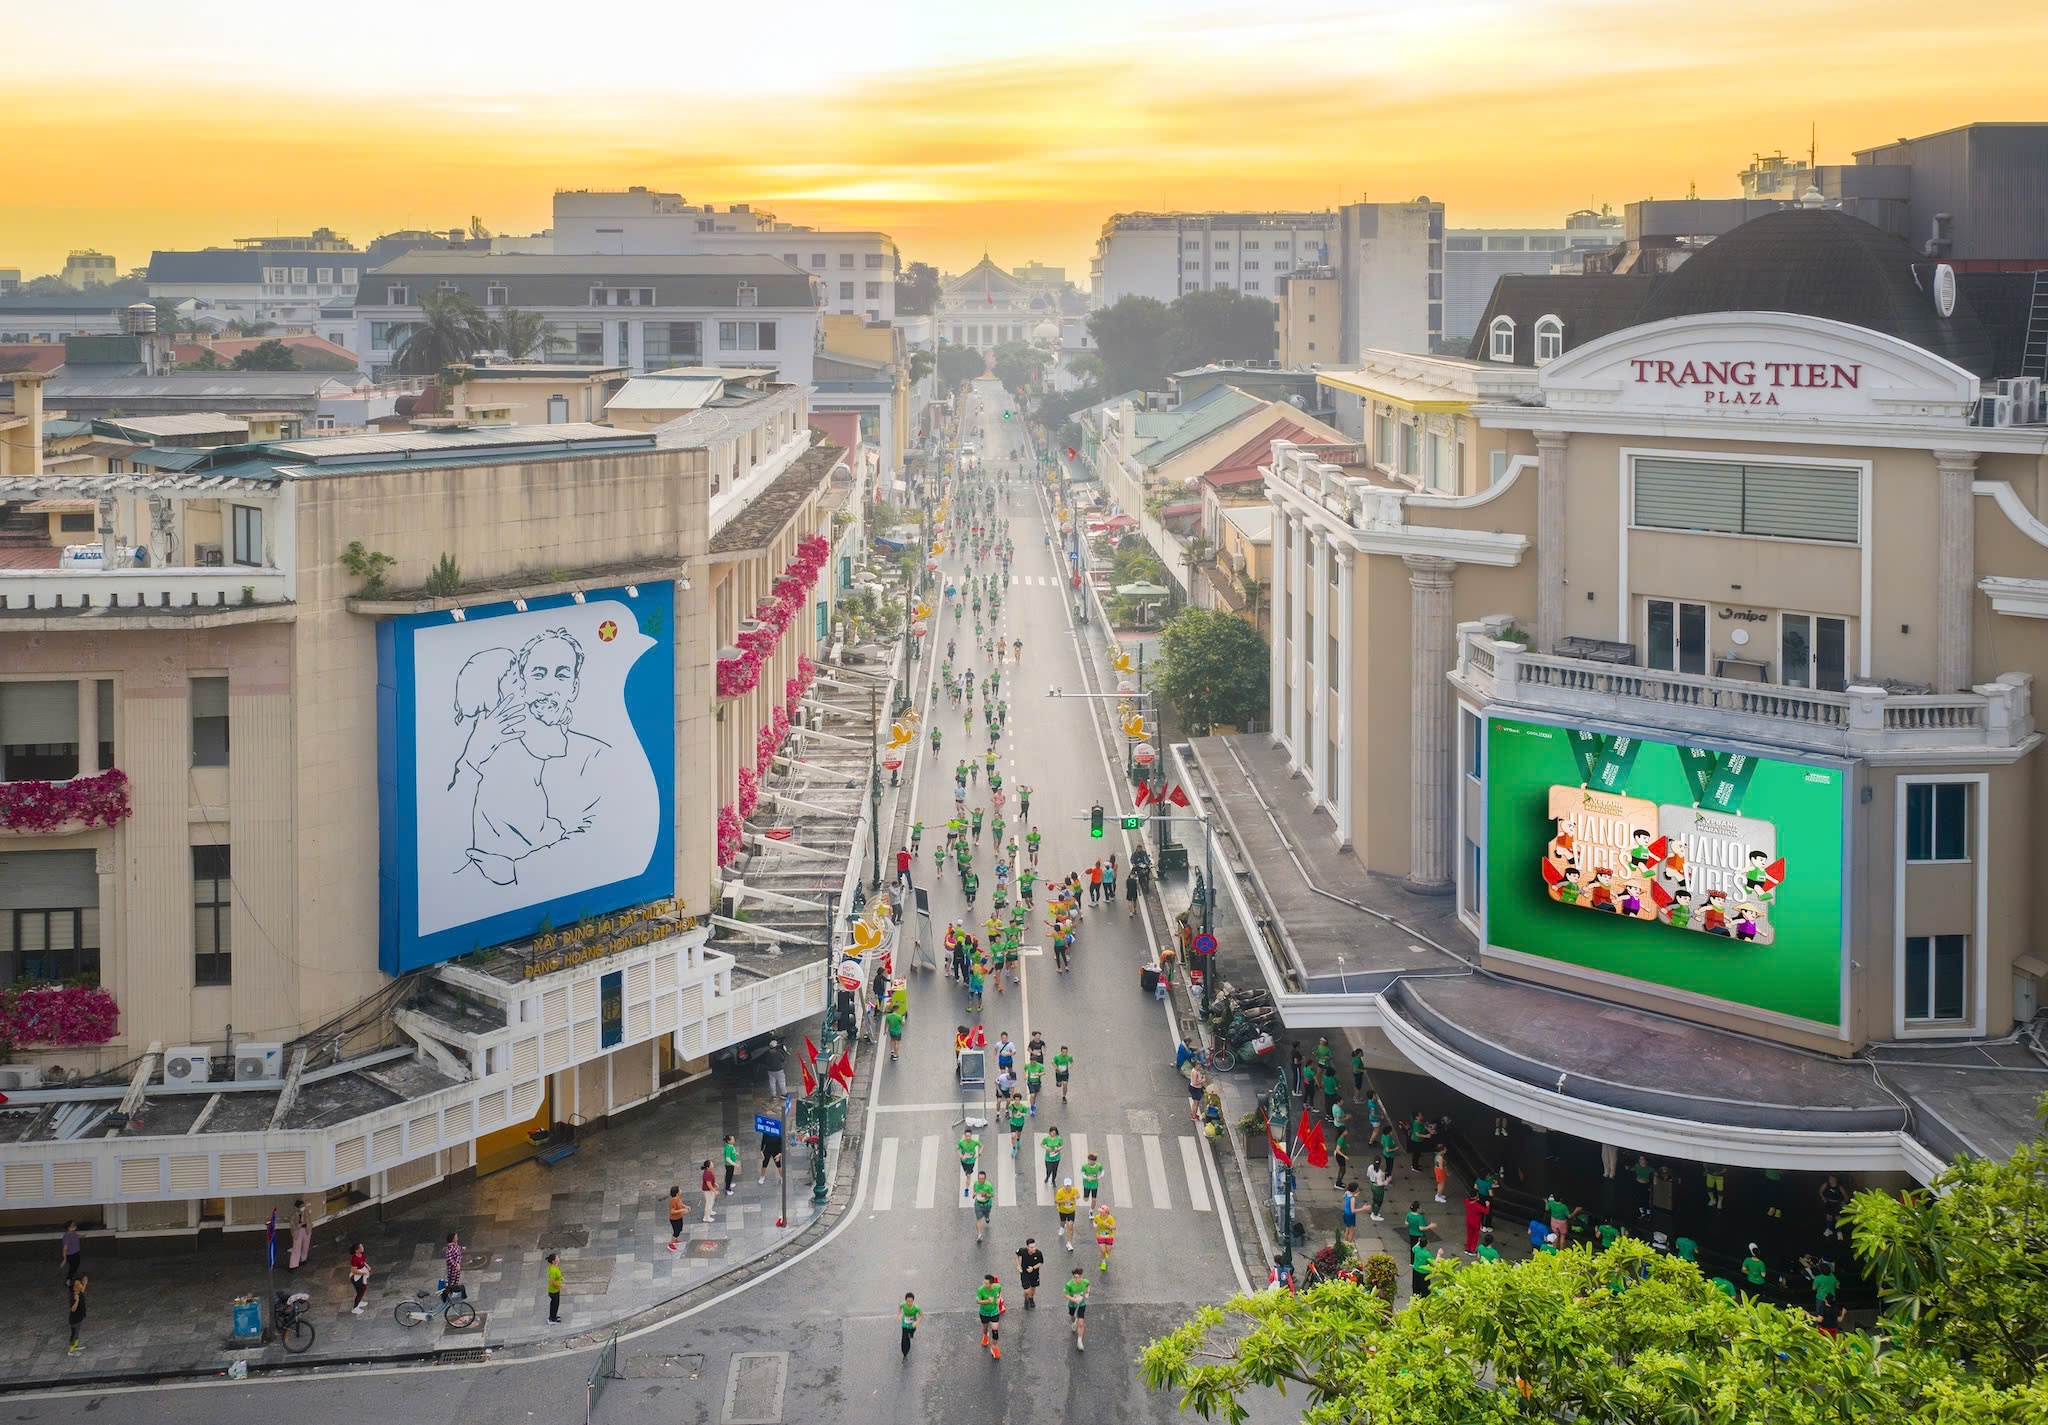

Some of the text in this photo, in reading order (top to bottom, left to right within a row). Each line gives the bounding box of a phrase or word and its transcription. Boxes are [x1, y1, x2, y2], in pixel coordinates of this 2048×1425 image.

[1631, 360, 1862, 389] TRANG TIEN
[1704, 391, 1780, 406] PLAZA
[1733, 609, 1769, 622] mipa
[1127, 819, 1136, 827] 19
[635, 930, 650, 945] TO
